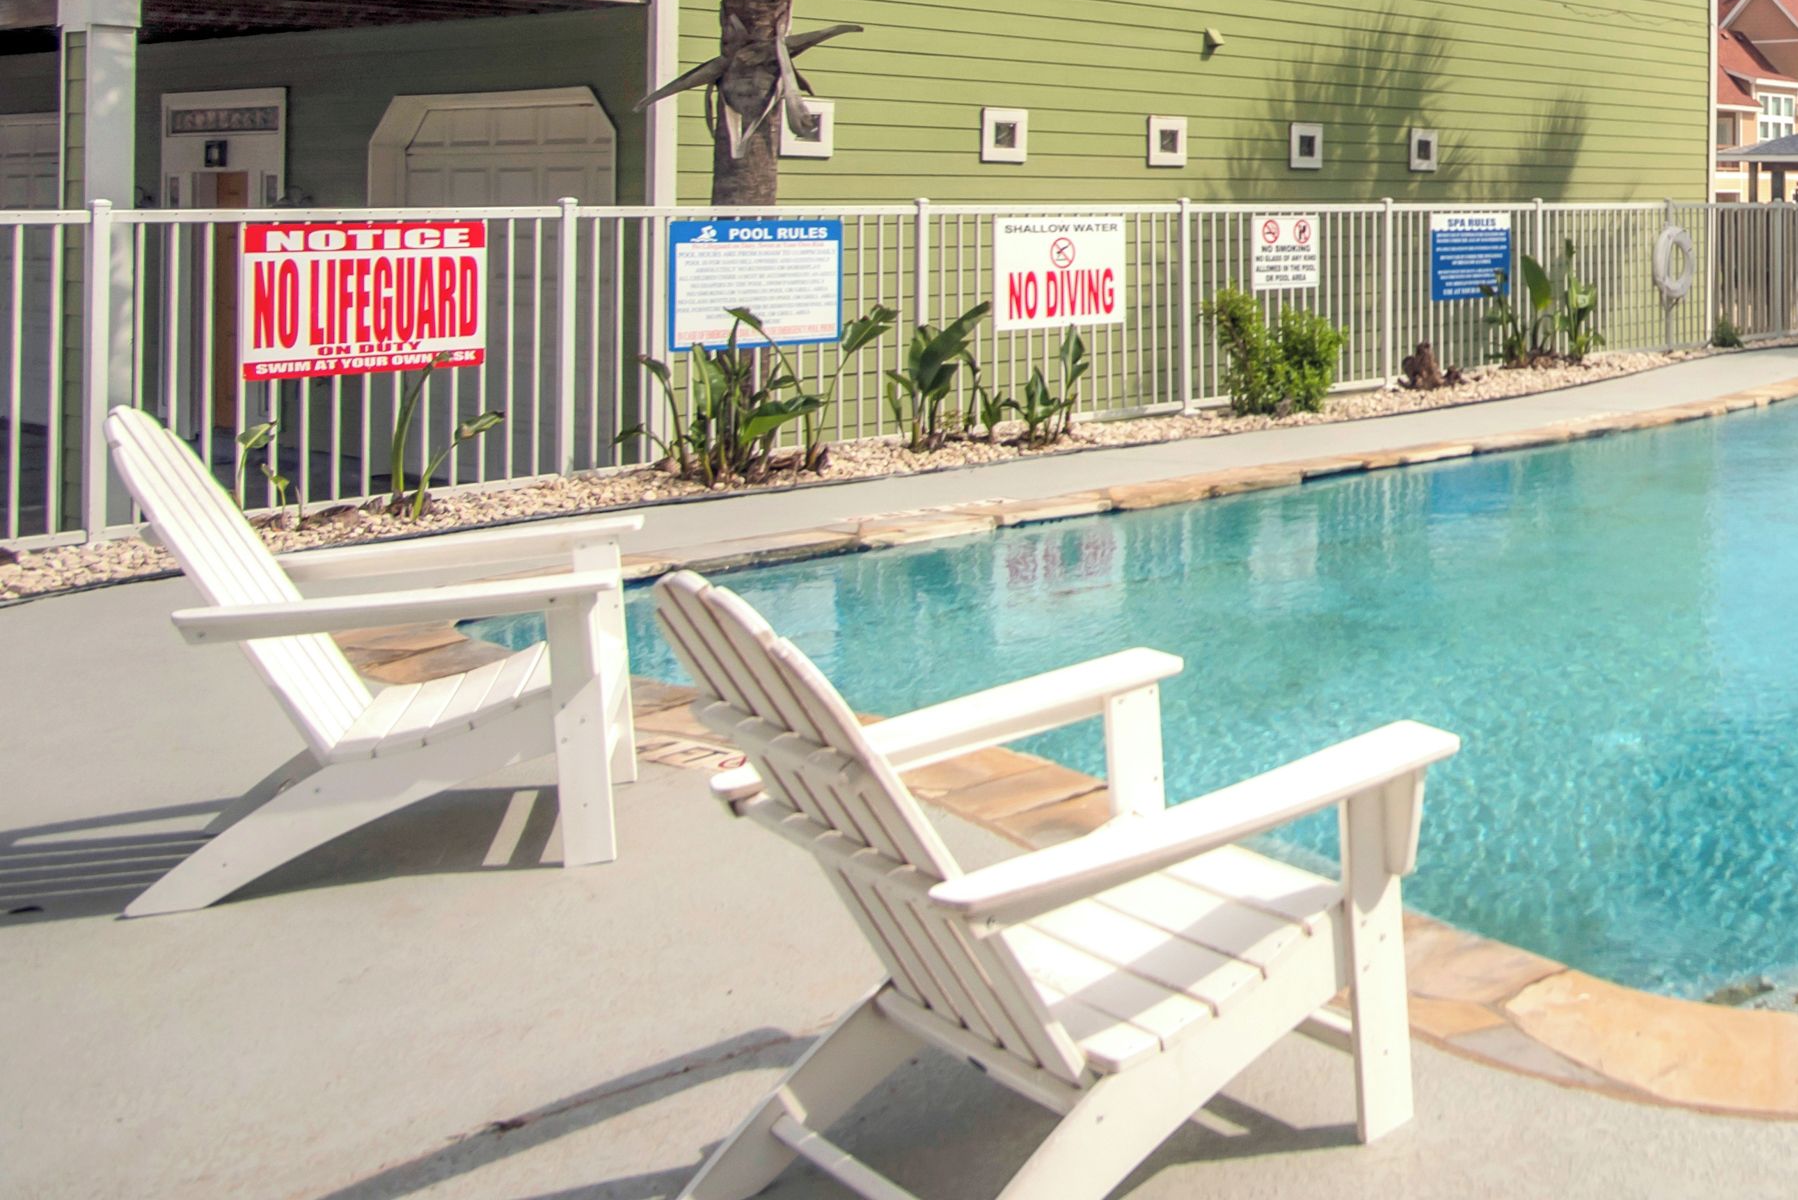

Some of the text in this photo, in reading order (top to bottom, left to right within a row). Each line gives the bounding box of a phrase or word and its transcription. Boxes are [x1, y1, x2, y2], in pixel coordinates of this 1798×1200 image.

[1004, 223, 1118, 233] SHALLOW WATER
[1447, 218, 1496, 227] SPA RULES
[266, 228, 470, 251] NOTICE
[728, 227, 828, 240] POOL RULES
[253, 256, 478, 349] NO LIFEGUARD
[1008, 267, 1114, 320] NO DIVING
[317, 341, 421, 356] ON DUTY
[255, 351, 477, 375] SWIM AT YOUR OWN SK
